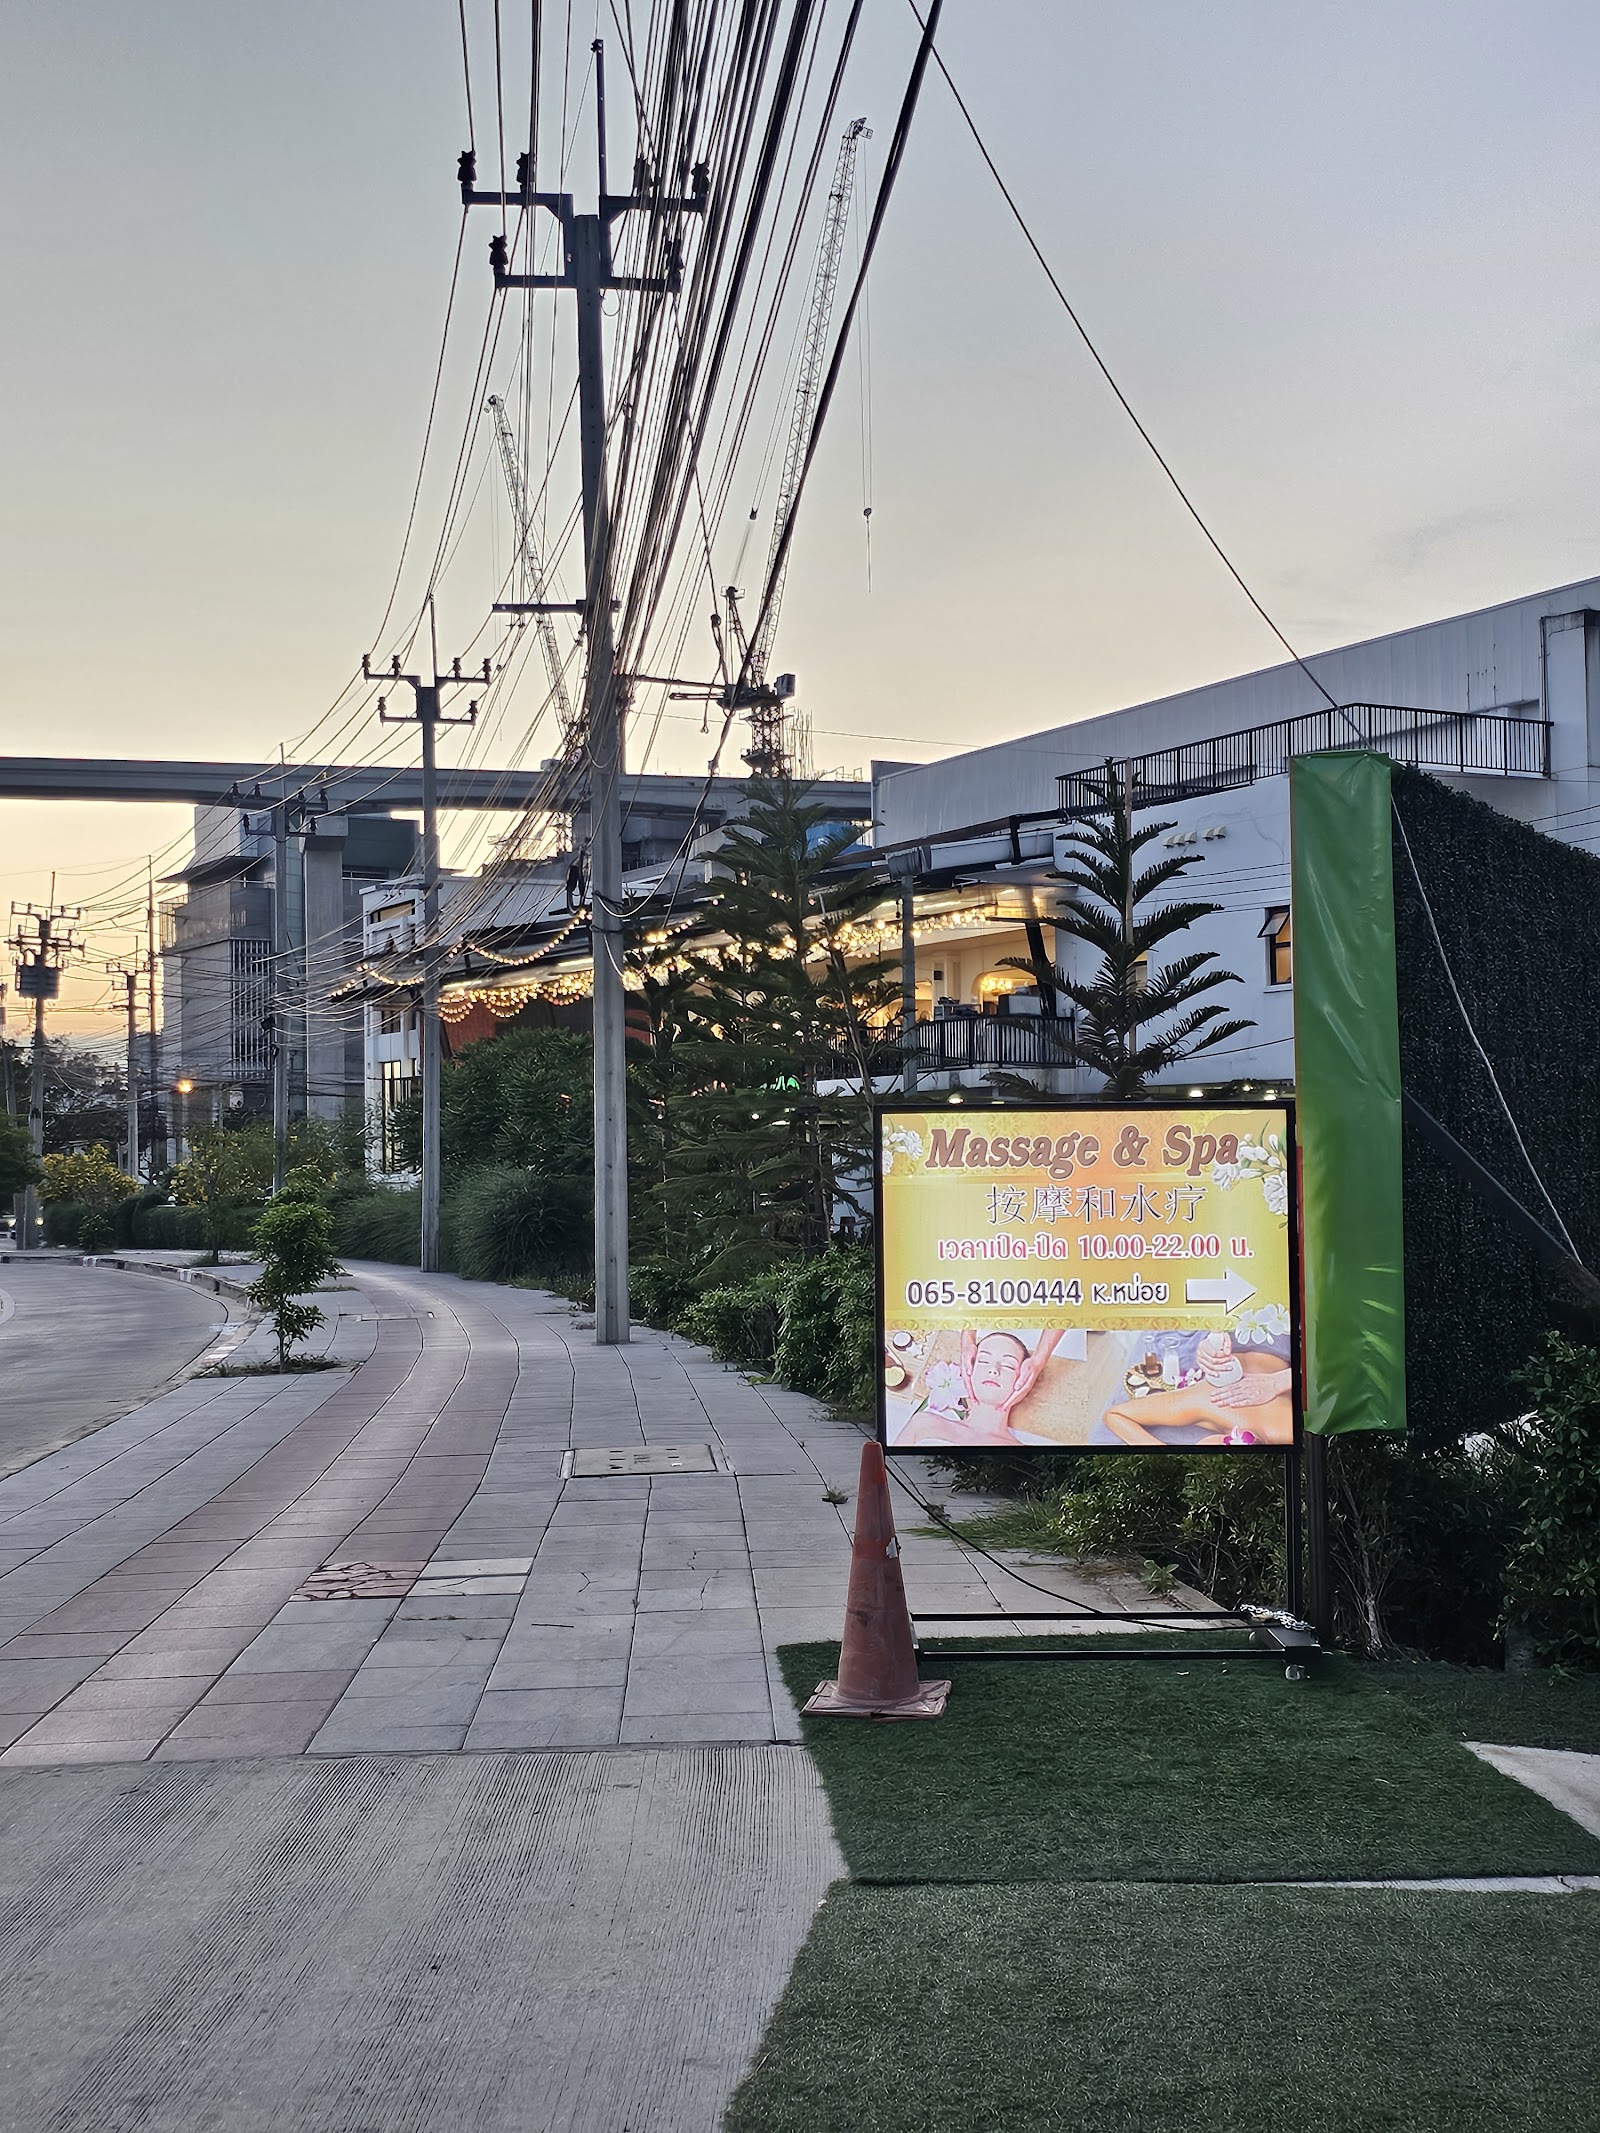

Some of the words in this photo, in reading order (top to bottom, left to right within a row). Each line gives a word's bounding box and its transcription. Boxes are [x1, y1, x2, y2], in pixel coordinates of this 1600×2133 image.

[925, 1129, 1100, 1180] Massage
[1113, 1124, 1149, 1167] &
[1161, 1124, 1239, 1177] Spa
[985, 1183, 1207, 1225] 按摩和水疗
[938, 1233, 1067, 1260] เวลาเปิด-ปิด
[1079, 1235, 1220, 1258] 10.00-22.00
[1231, 1238, 1254, 1258] น.
[907, 1281, 1082, 1306] 065-8100444
